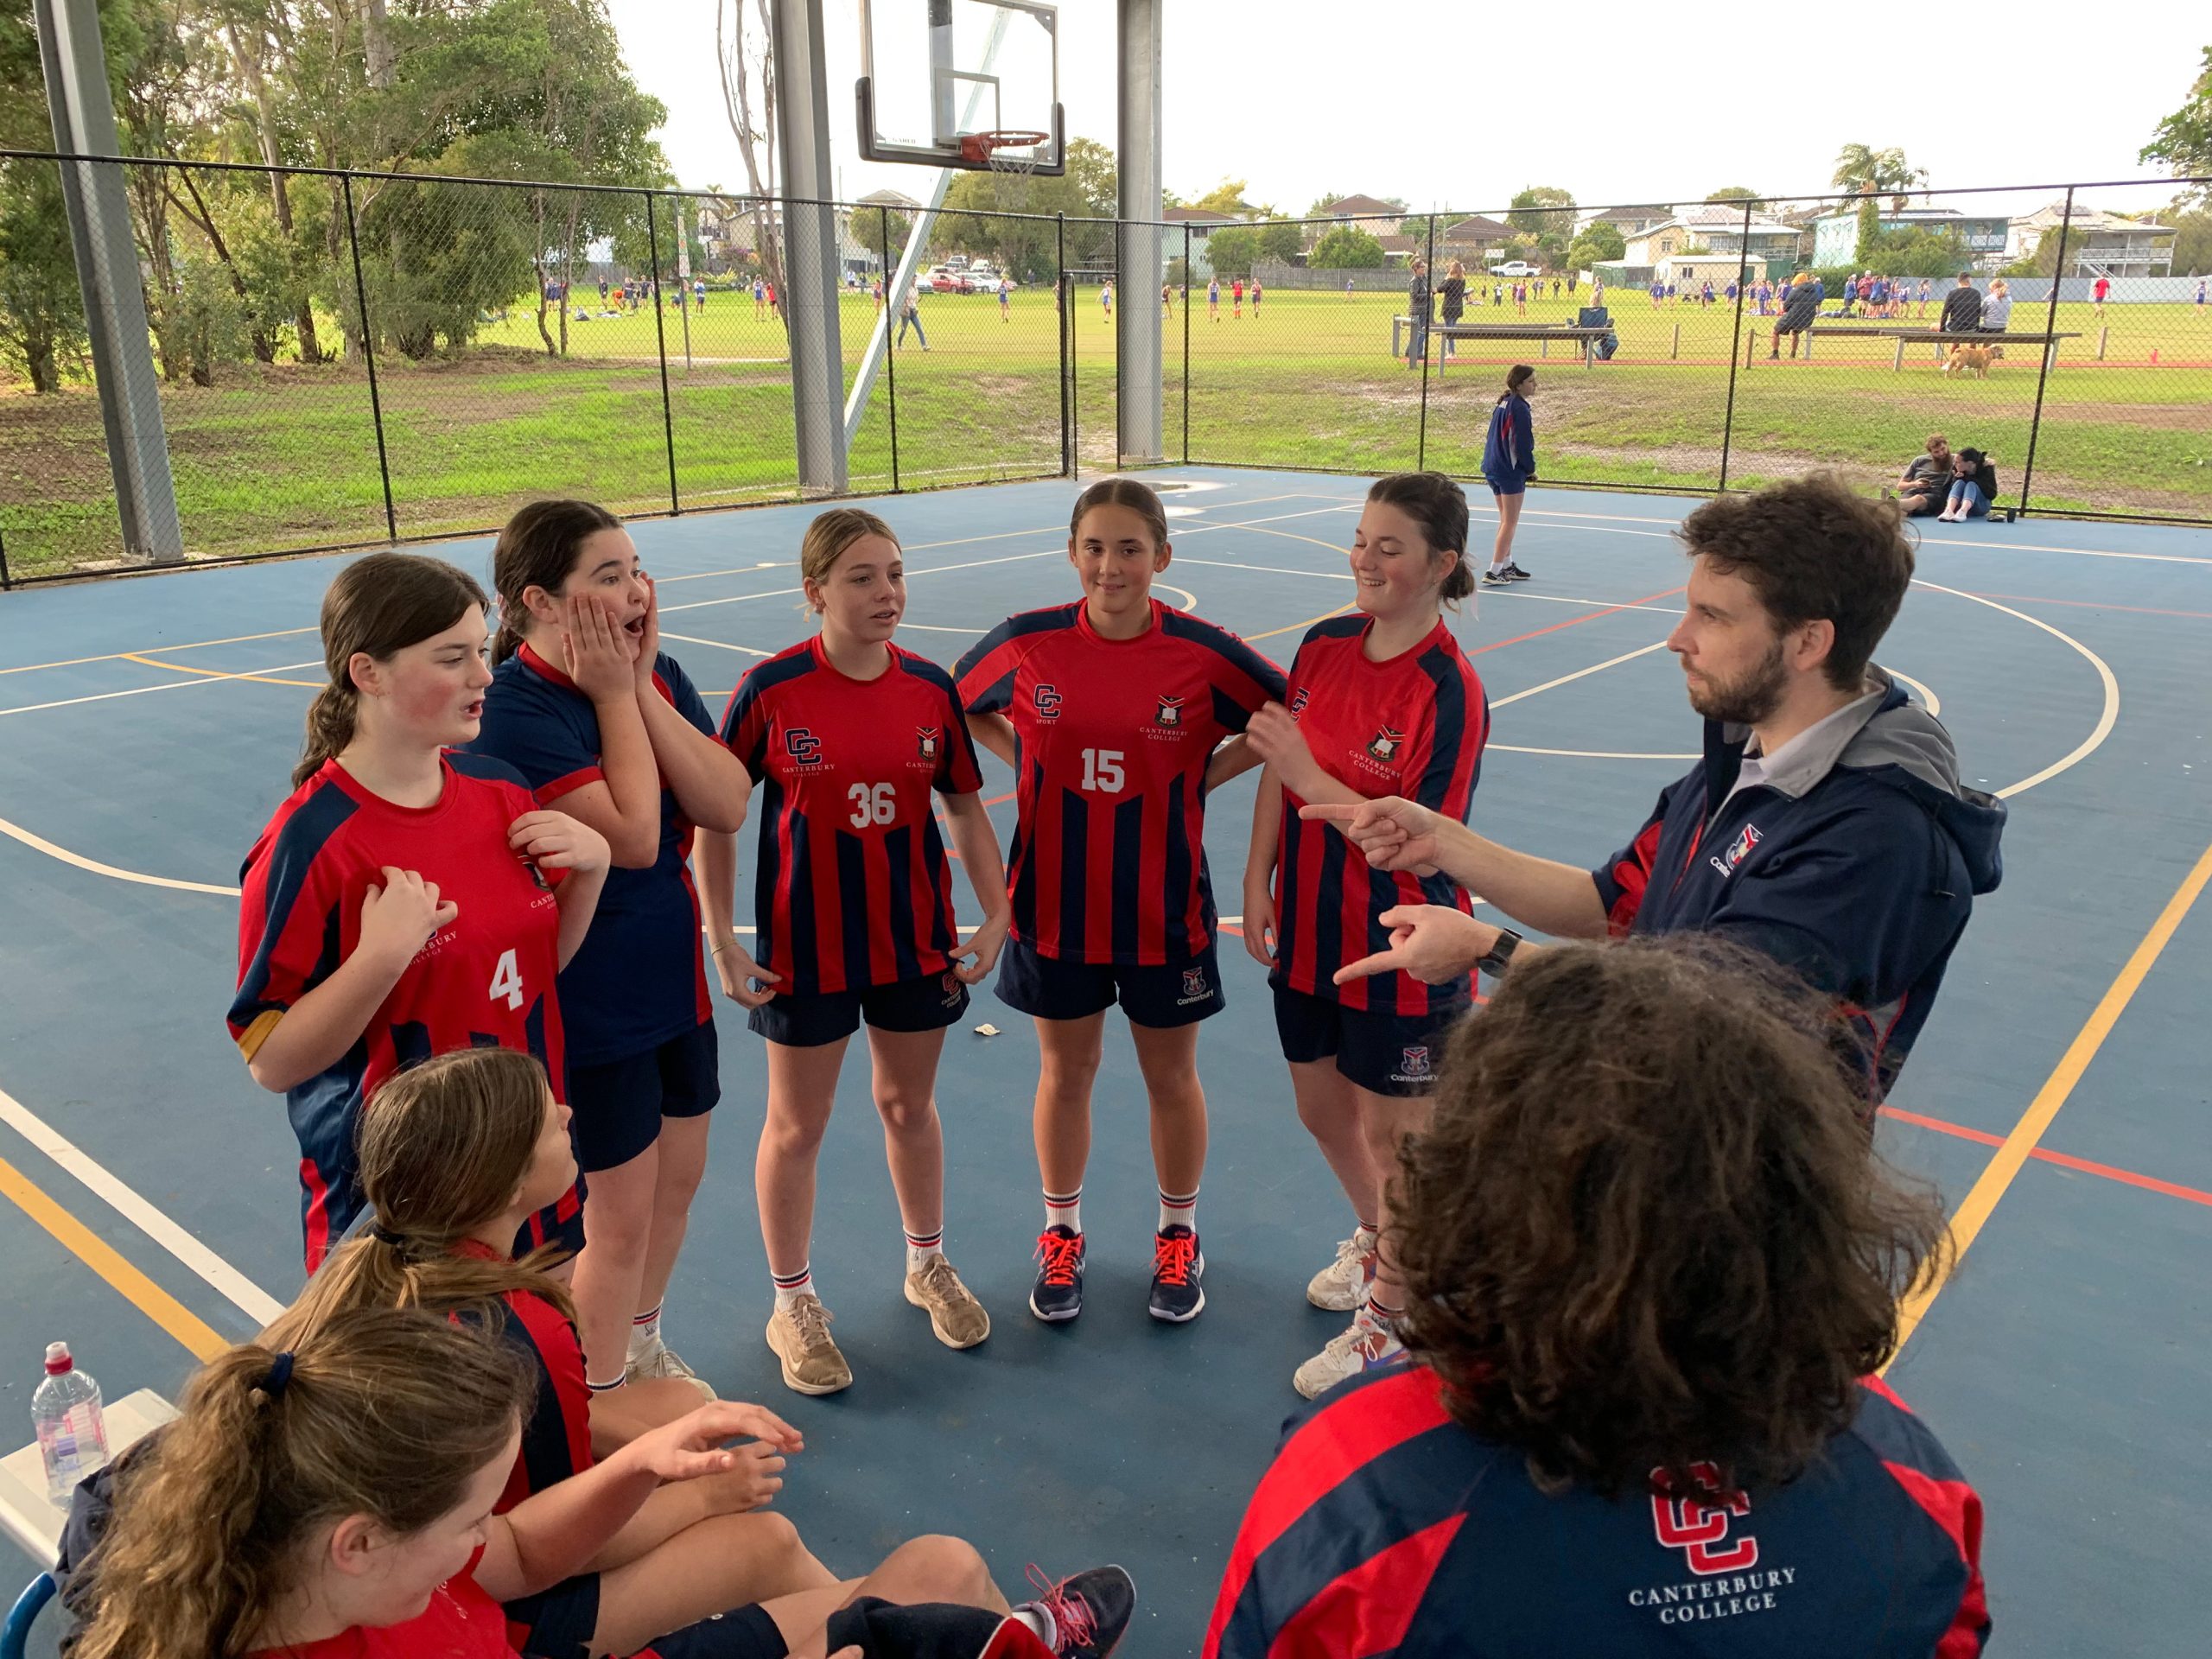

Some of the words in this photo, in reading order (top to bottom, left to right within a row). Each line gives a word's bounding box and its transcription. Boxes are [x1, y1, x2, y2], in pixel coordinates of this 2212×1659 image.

[1139, 727, 1188, 736] CANTERBURY
[1147, 734, 1181, 742] COLLEGE
[782, 764, 836, 773] CANTERBURY
[1081, 747, 1125, 793] 15
[1348, 749, 1402, 779] CANTERBURY
[1353, 760, 1391, 781] COLLEGE
[847, 782, 896, 830] 36
[488, 947, 524, 1012] 4
[1177, 988, 1214, 1006] Canterbury
[1628, 1567, 1796, 1607] CANTERBURY
[1659, 1592, 1777, 1624] COLLEGE
